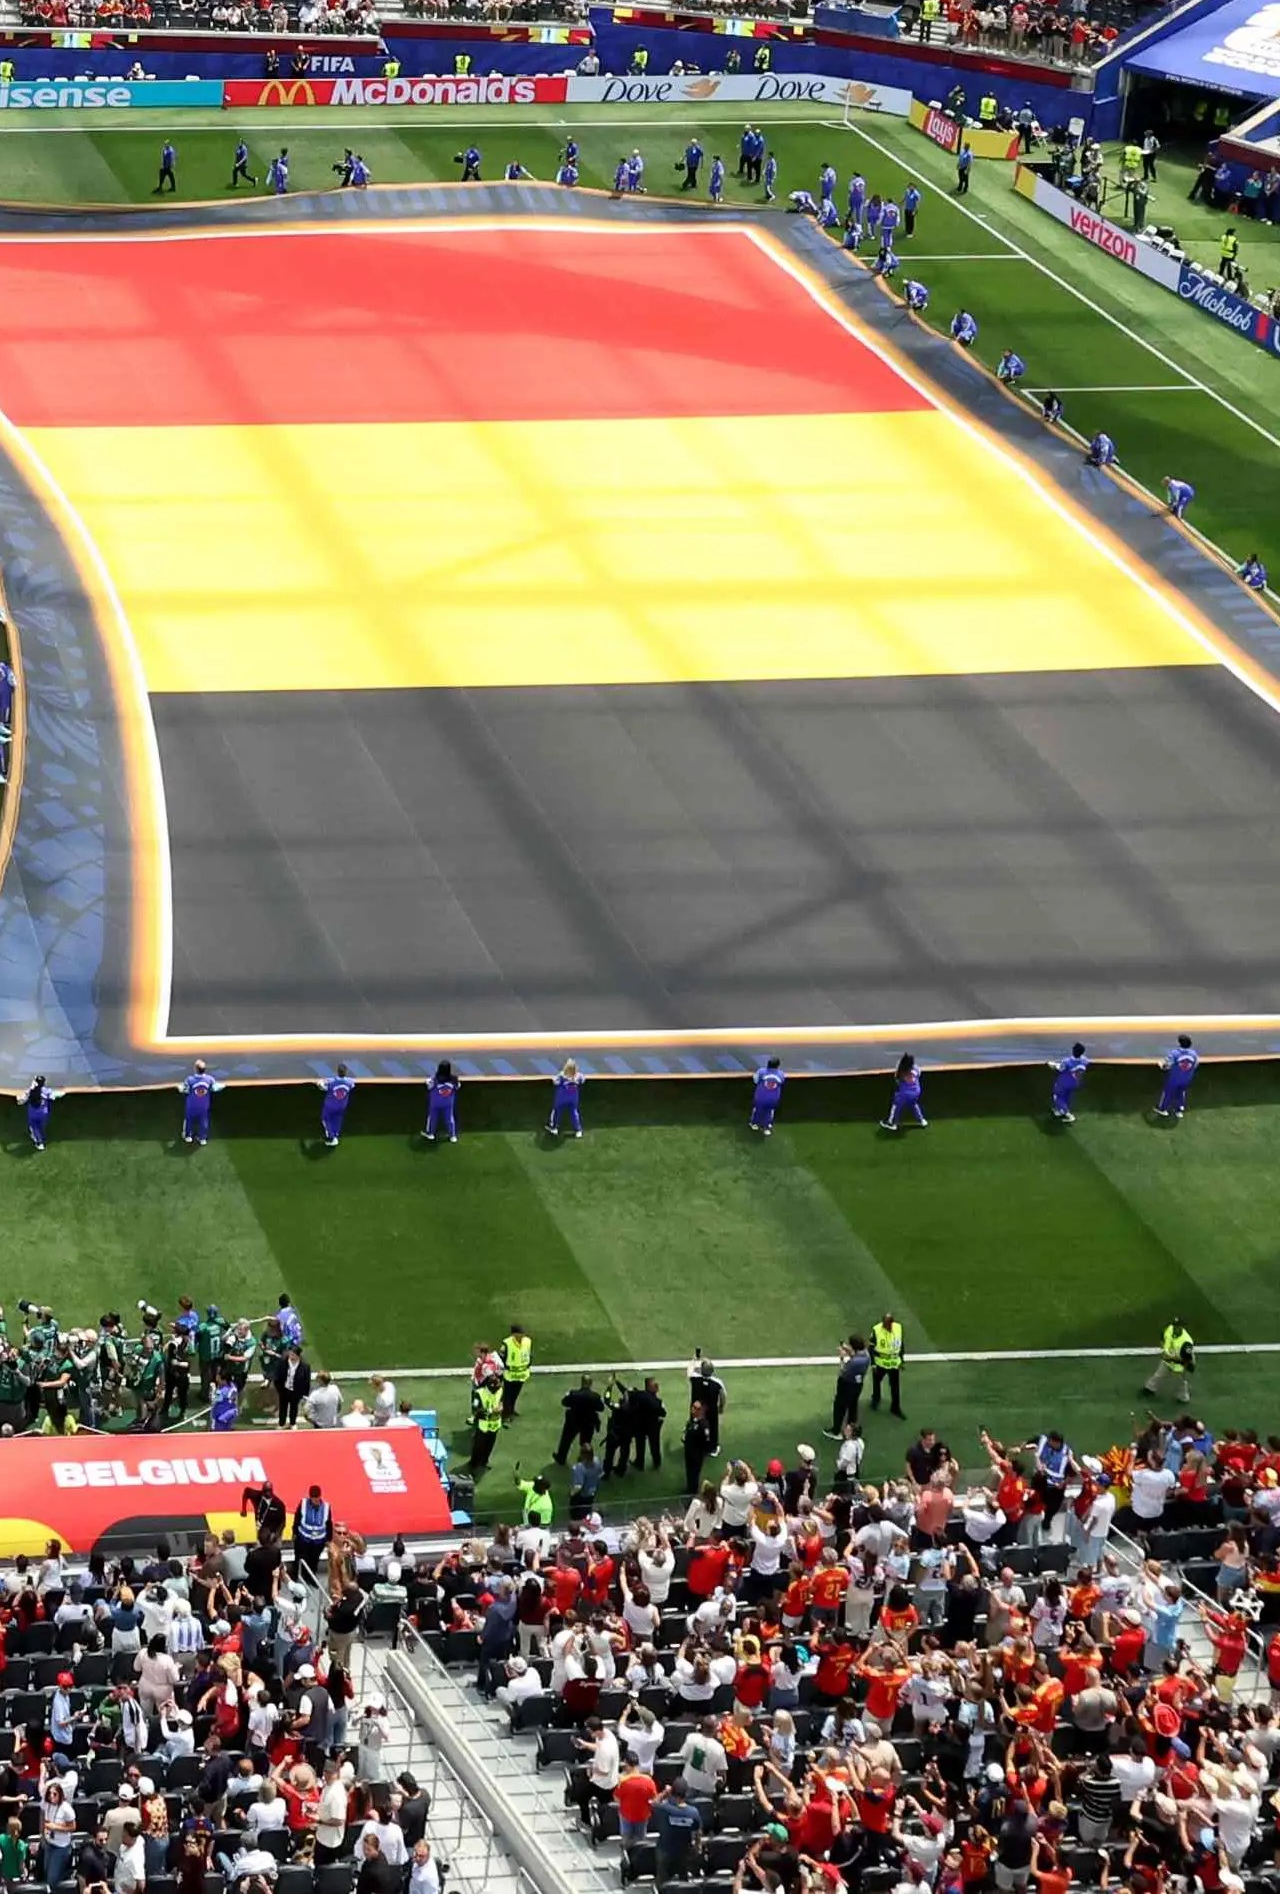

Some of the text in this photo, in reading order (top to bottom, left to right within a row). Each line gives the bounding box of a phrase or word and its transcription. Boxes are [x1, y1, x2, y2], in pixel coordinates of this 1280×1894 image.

[310, 56, 355, 73] FIFA
[329, 77, 536, 104] McDonald's
[601, 78, 673, 102] Dove
[754, 75, 825, 101] Dove
[1070, 205, 1138, 266] verizon
[1180, 272, 1253, 331] Michelob
[51, 1456, 268, 1488] BELGIUM
